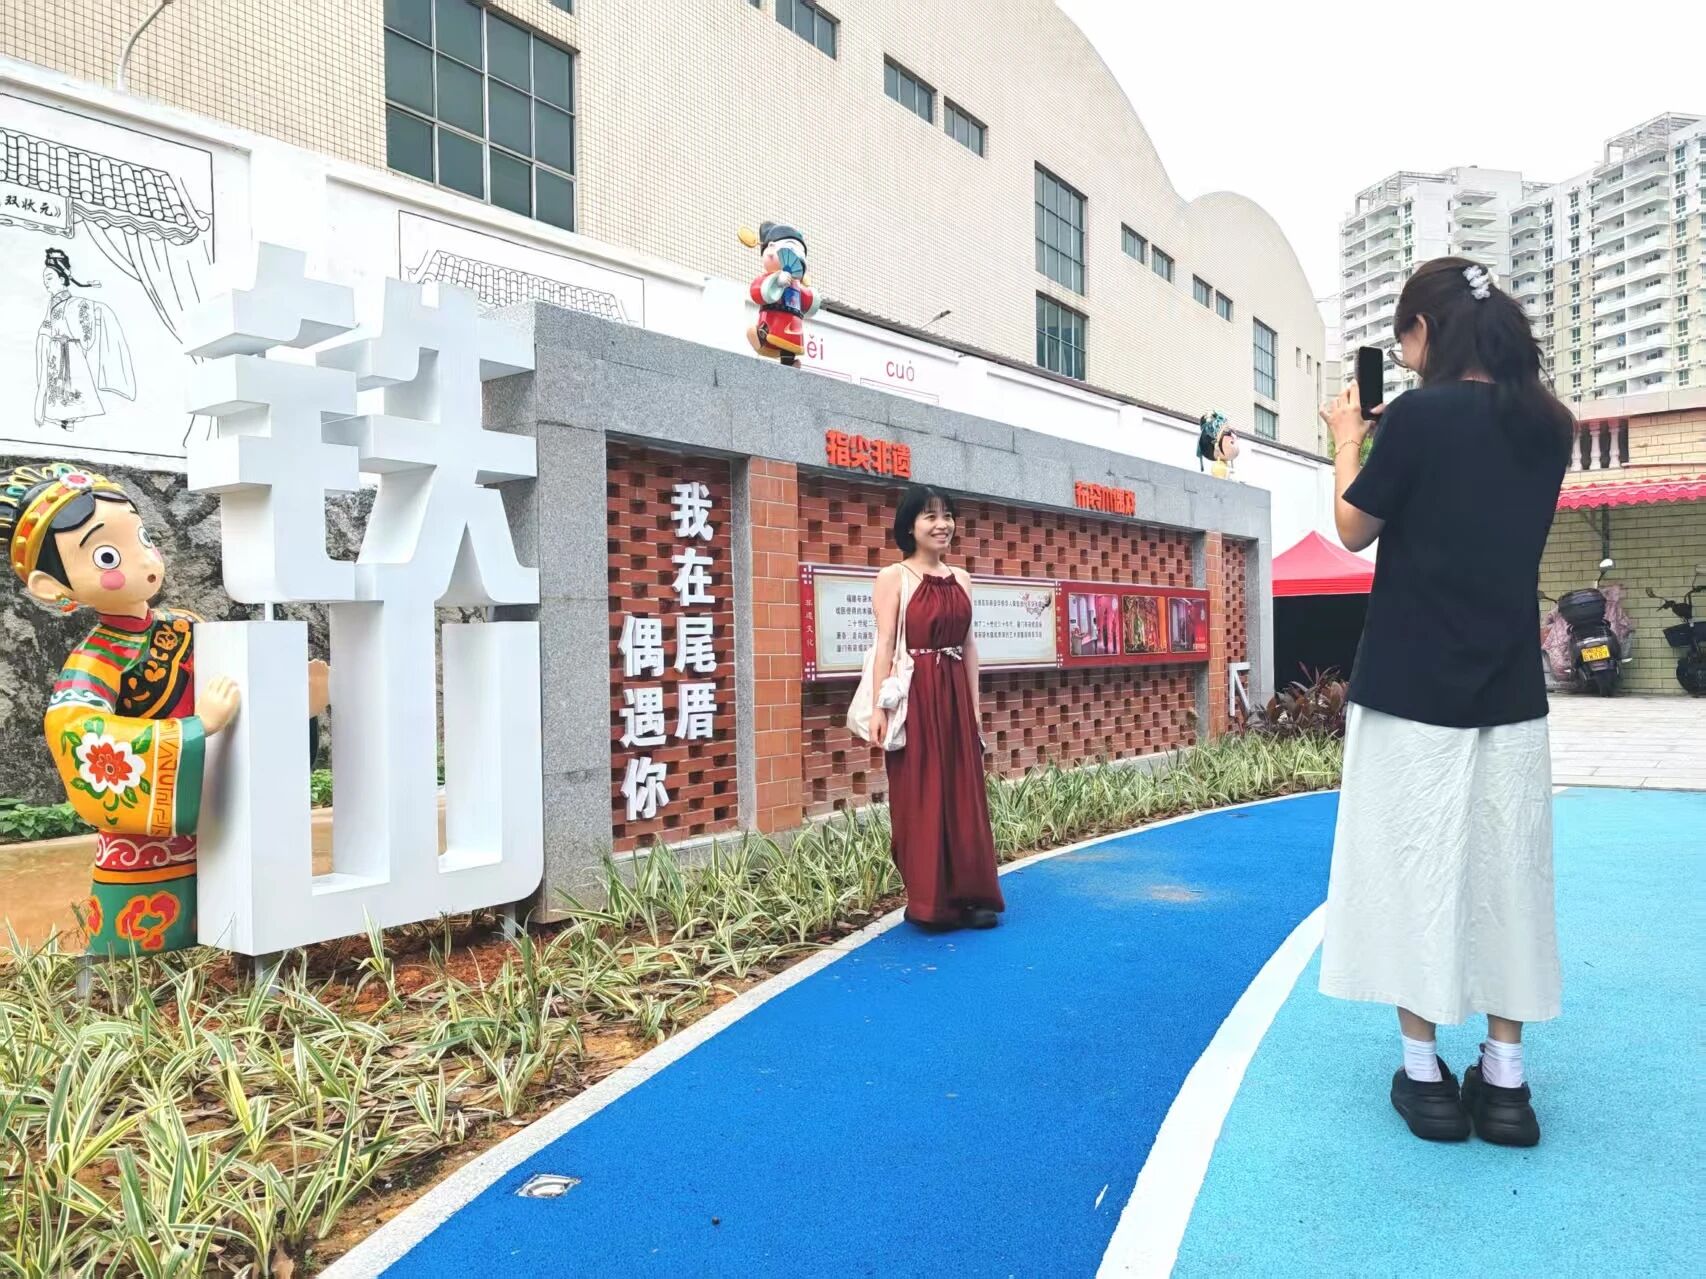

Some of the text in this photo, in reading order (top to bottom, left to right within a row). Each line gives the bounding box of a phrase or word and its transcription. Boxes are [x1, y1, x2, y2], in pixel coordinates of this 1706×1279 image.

[0, 195, 61, 218] 双状元》
[805, 333, 824, 360] ěi
[825, 429, 911, 480] 指尖非遗
[1075, 480, 1136, 517] 布袋木偶戏
[671, 481, 718, 742] 我在尾厝
[617, 614, 670, 823] 偶遇你
